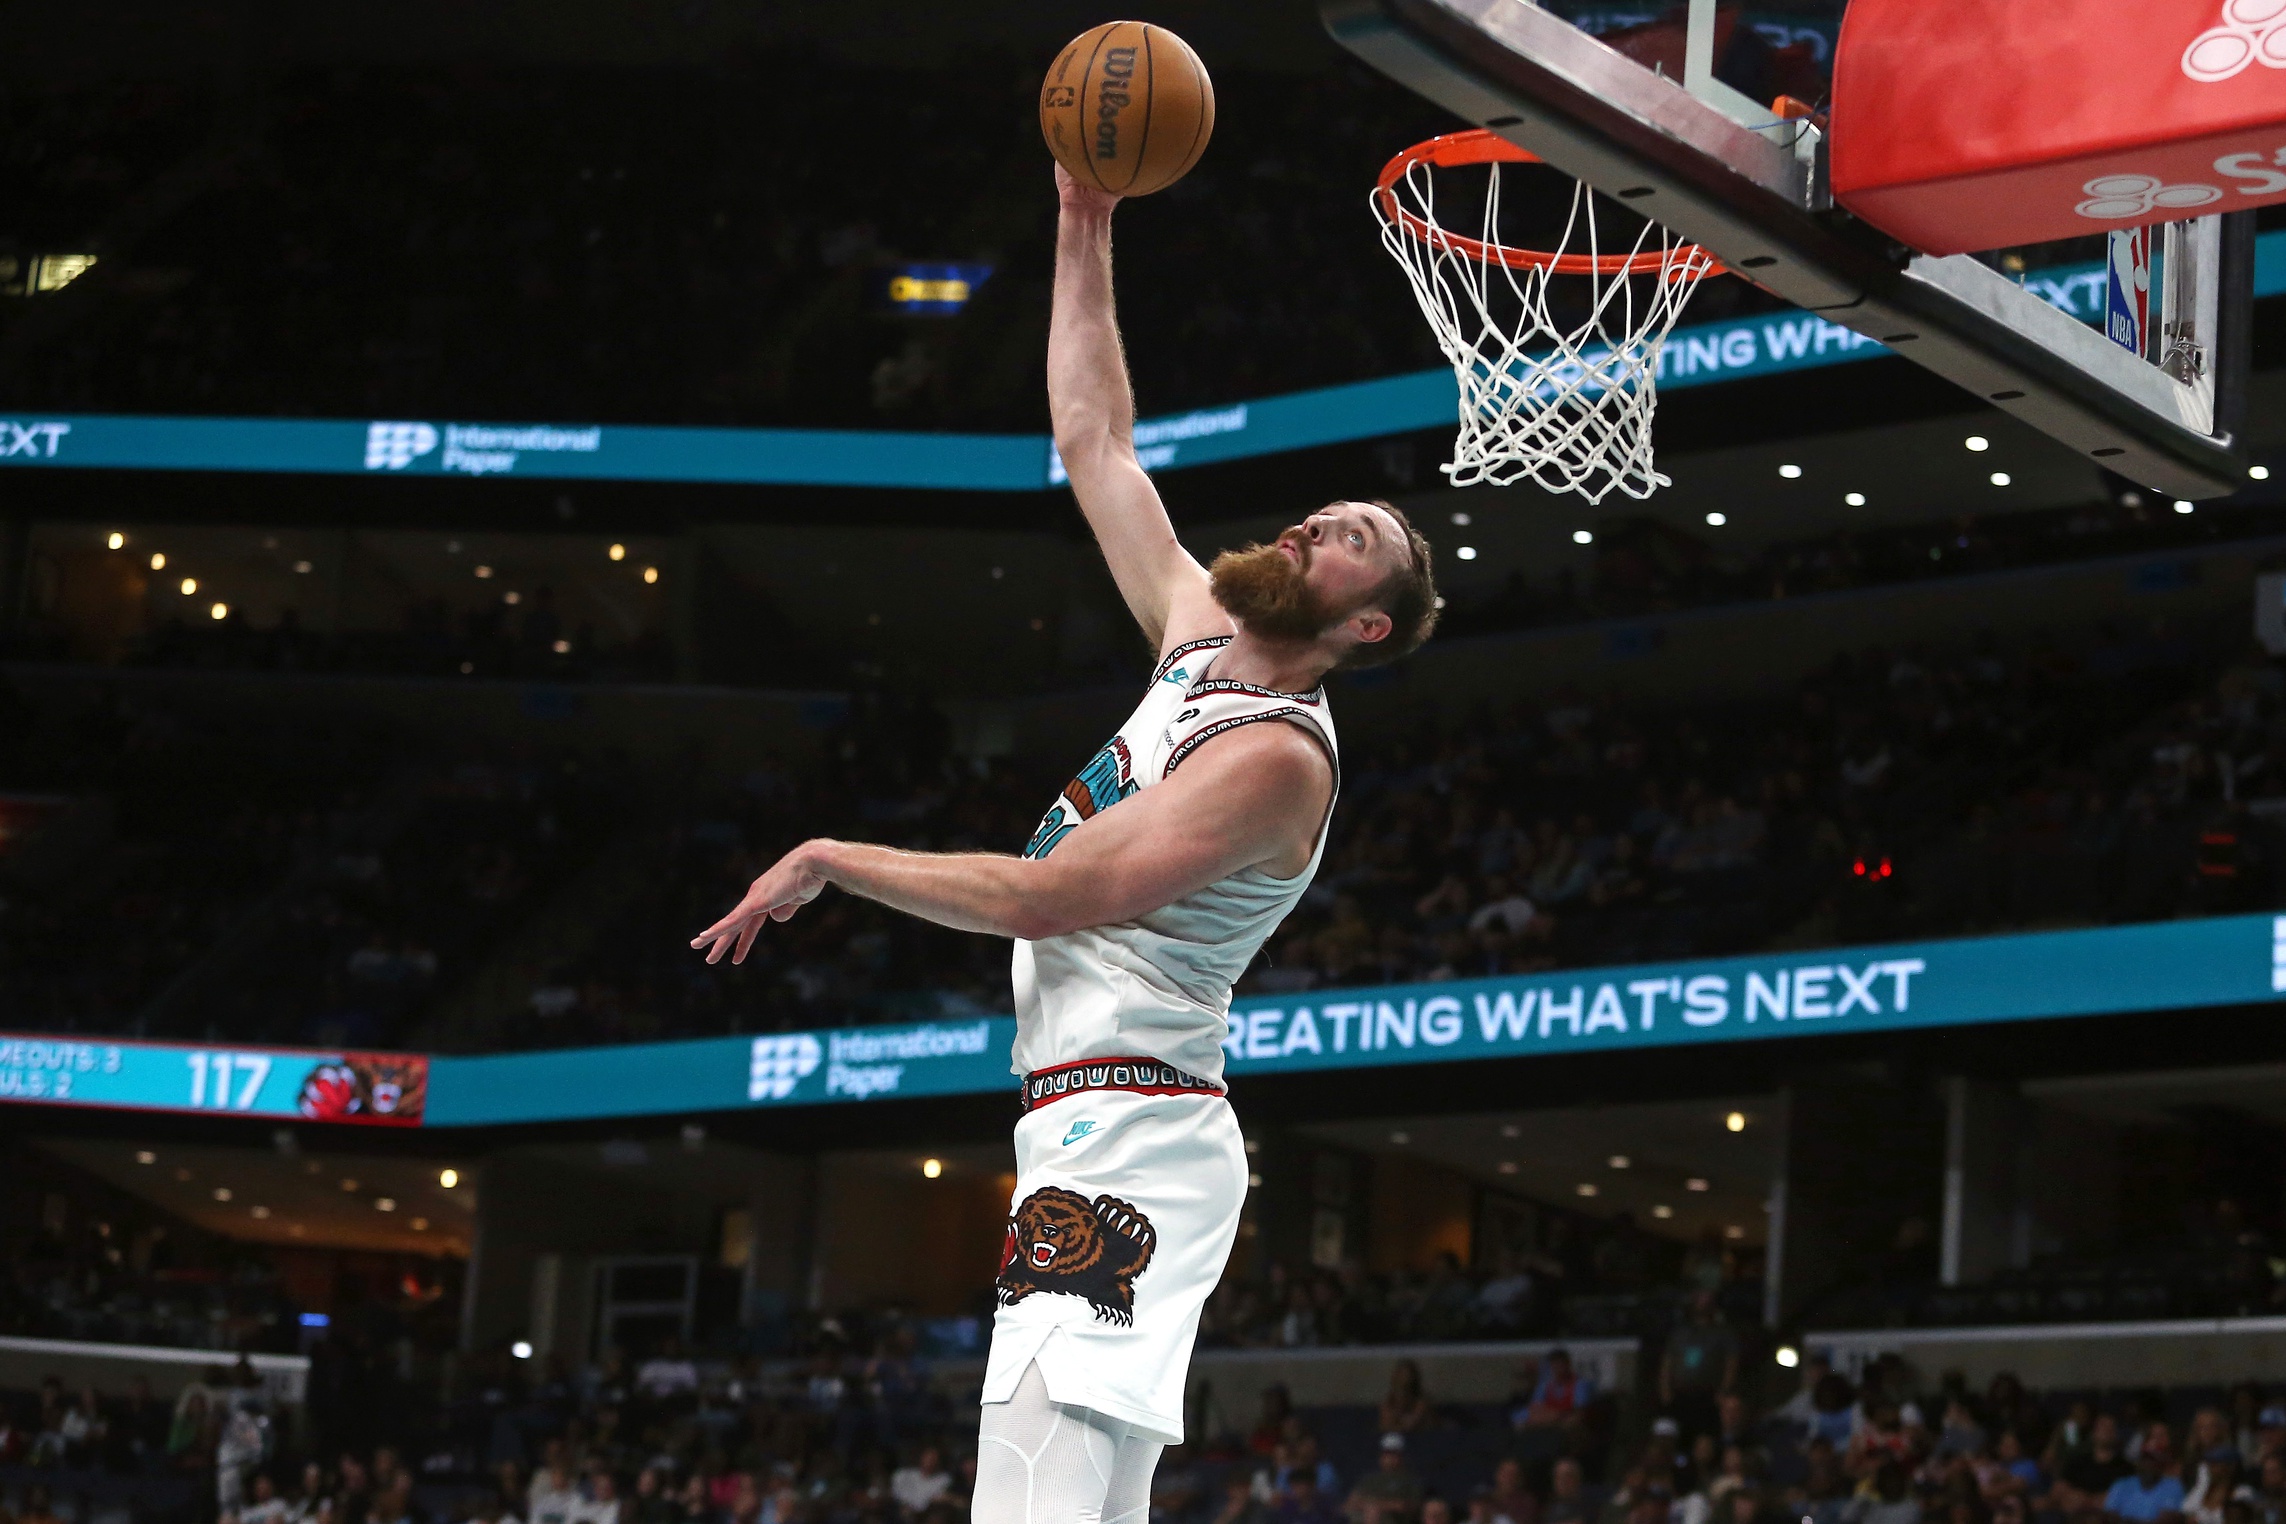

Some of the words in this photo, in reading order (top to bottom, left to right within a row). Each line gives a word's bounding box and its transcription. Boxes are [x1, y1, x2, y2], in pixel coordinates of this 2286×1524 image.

[1096, 47, 1138, 159] Wilson
[2111, 311, 2132, 348] NBA
[1474, 975, 1730, 1042] WHAT'S
[1743, 957, 1926, 1023] NEXT
[188, 1052, 271, 1111] 117
